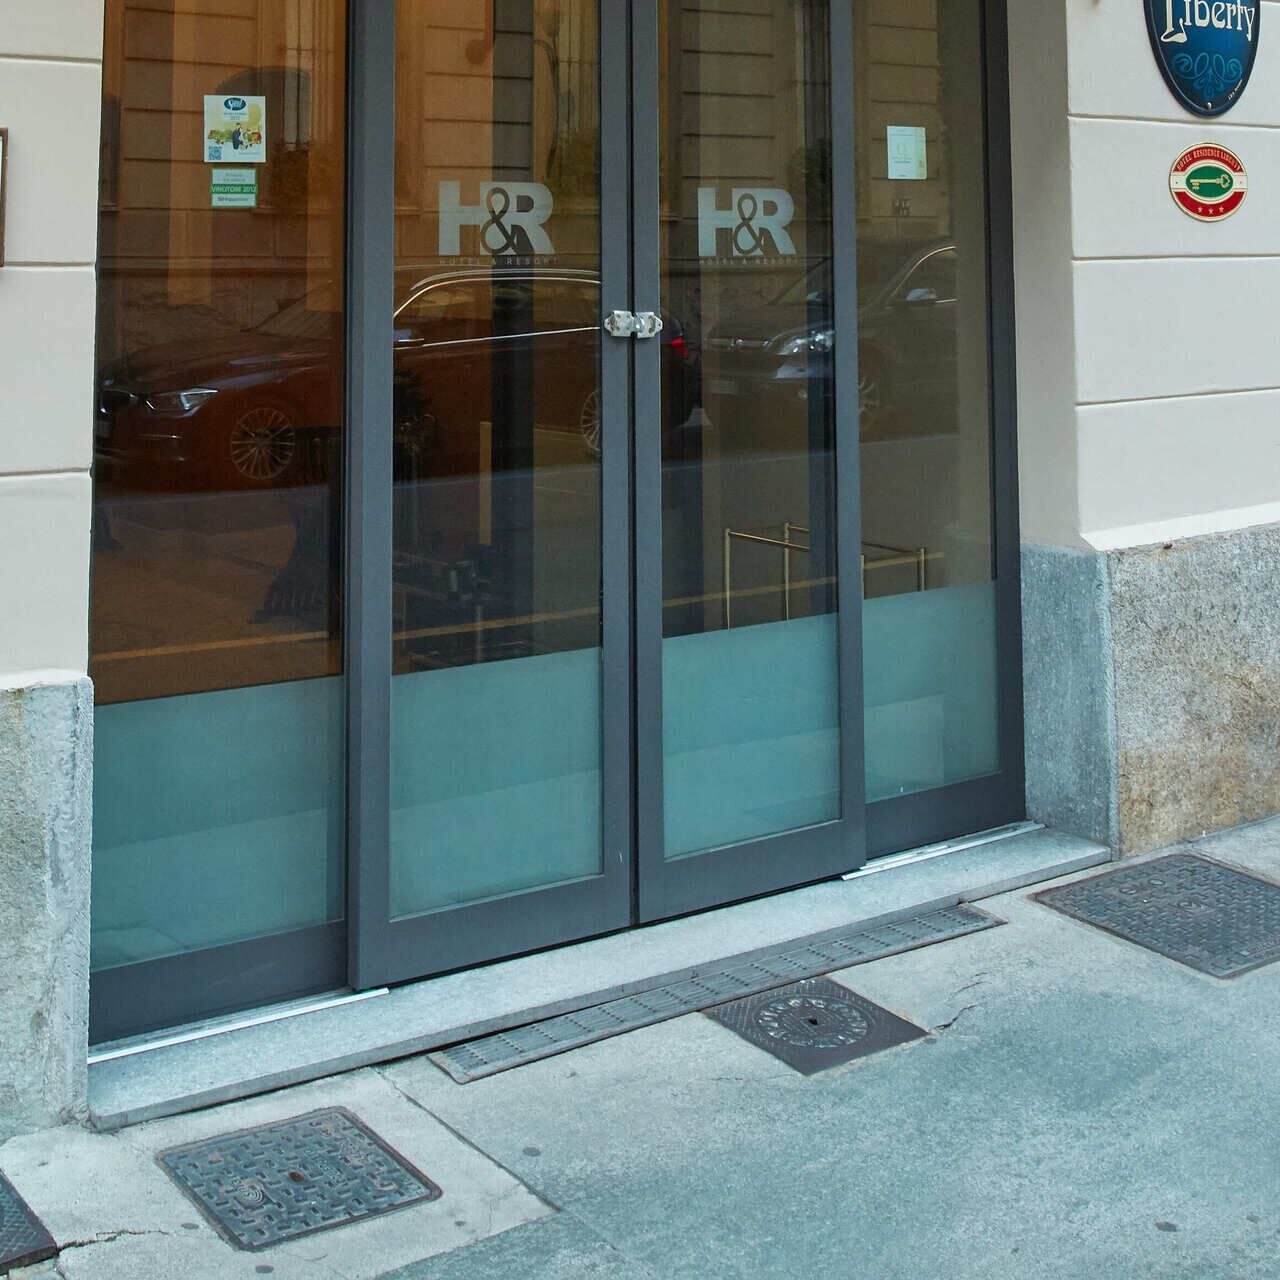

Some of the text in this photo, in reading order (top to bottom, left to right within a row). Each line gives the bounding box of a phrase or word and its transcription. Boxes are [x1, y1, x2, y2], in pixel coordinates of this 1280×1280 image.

[1176, 148, 1241, 171] HOTEL RESIDENCE LIBERTY
[438, 180, 557, 256] H&R
[698, 187, 797, 256] H&R
